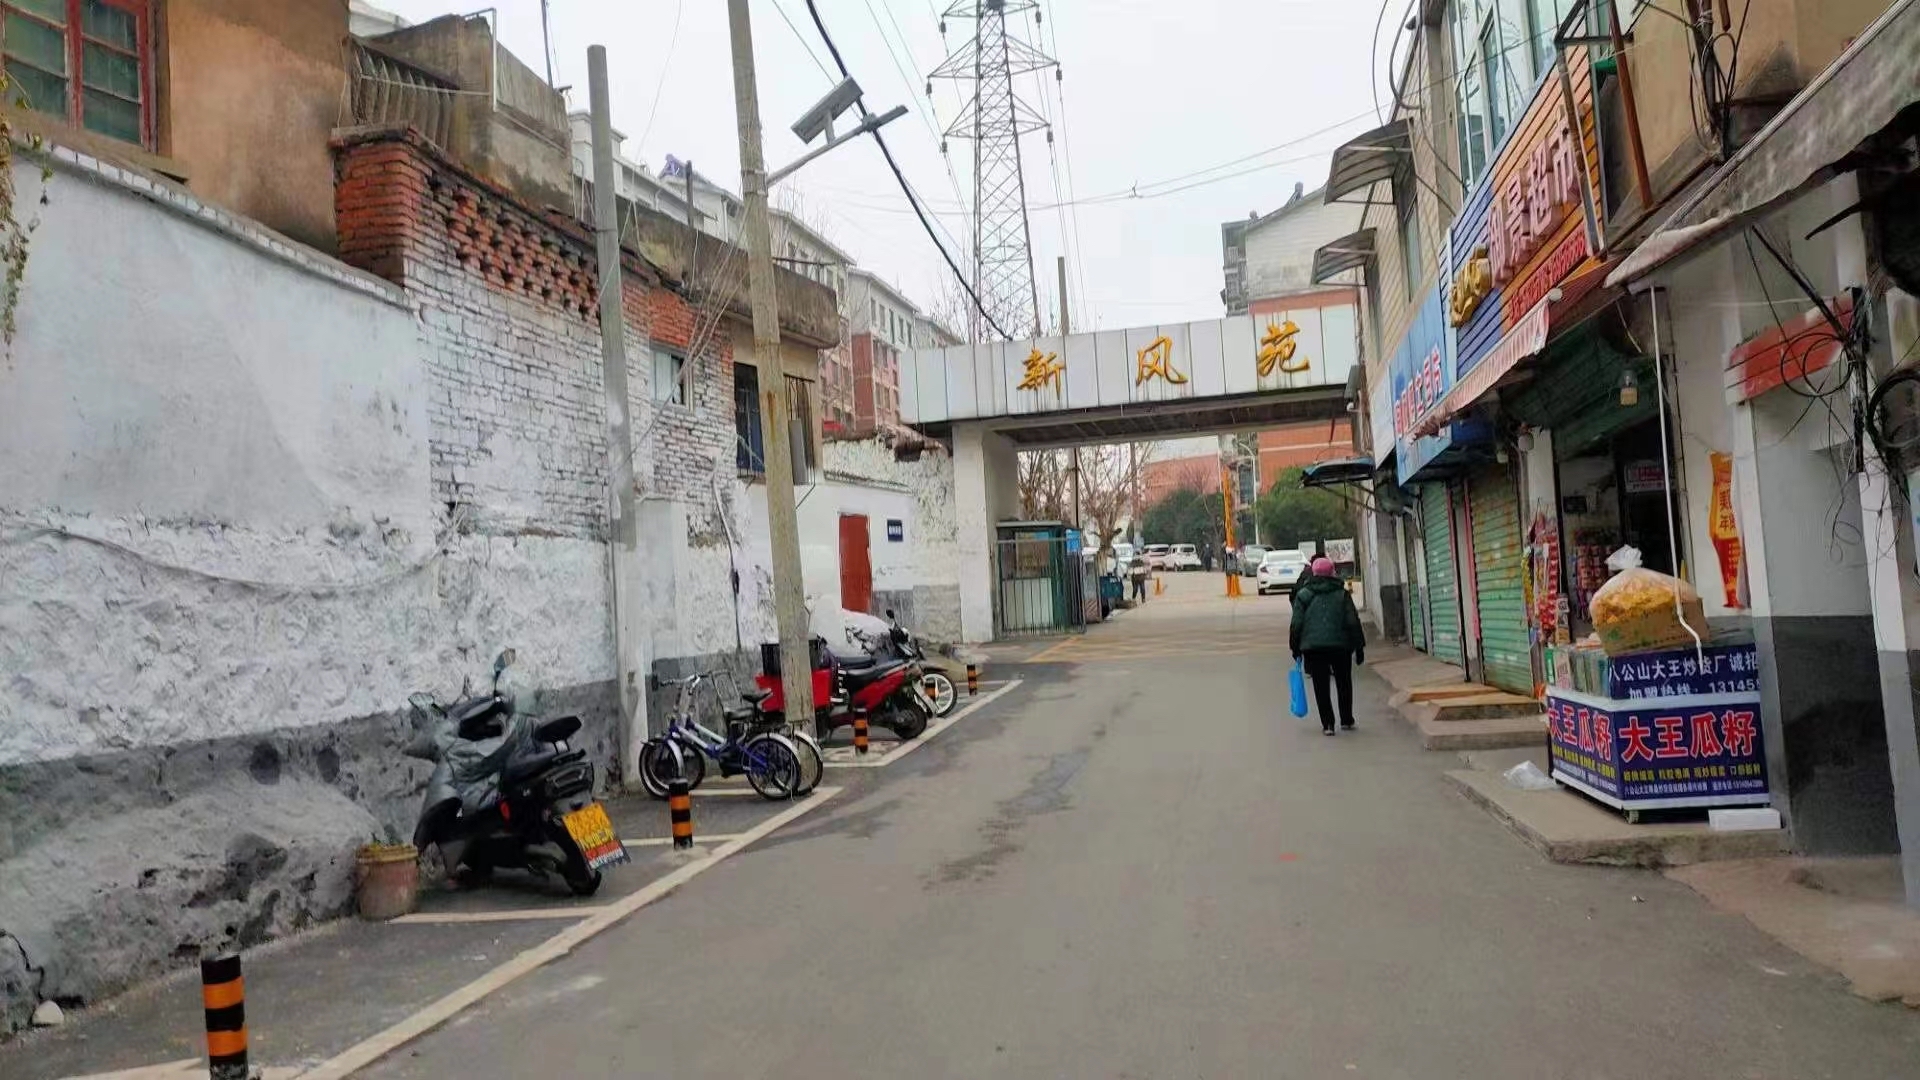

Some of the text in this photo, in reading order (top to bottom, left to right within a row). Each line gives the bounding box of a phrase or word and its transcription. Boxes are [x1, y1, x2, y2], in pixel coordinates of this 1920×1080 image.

[1017, 320, 1310, 399] 新风苑
[1547, 704, 1612, 762] 大王瓜籽
[1619, 712, 1757, 763] 大王瓜籽
